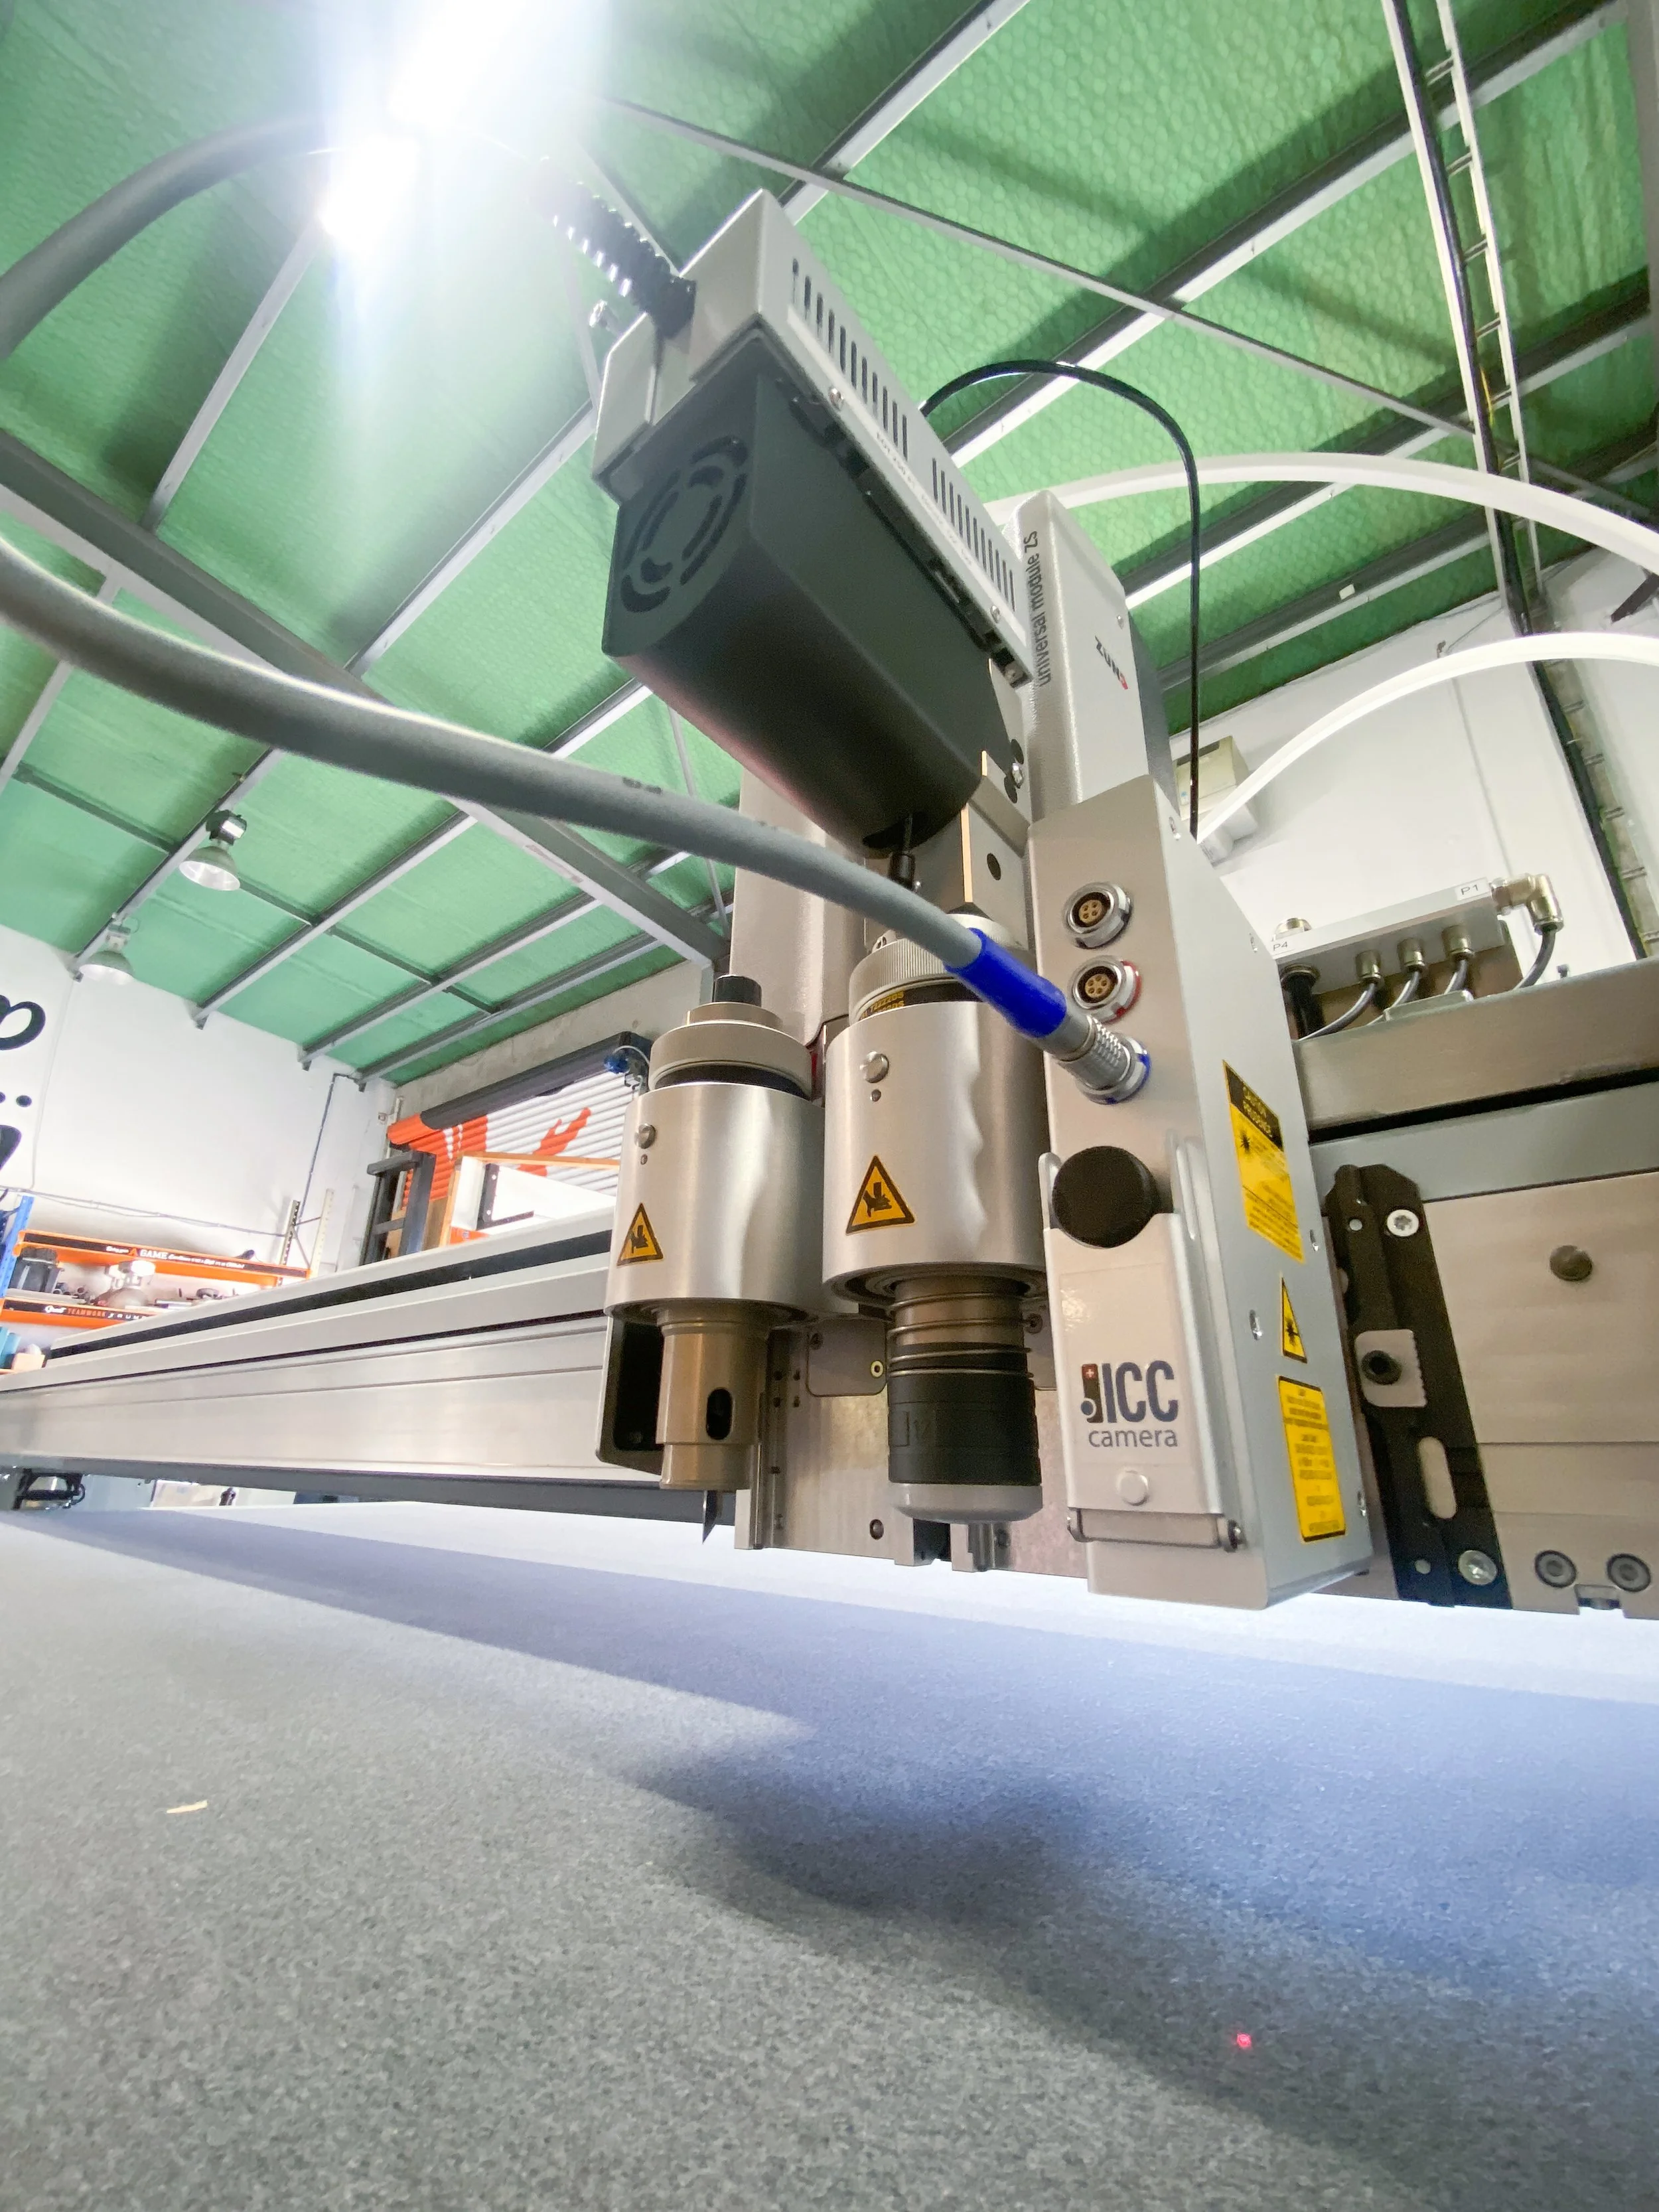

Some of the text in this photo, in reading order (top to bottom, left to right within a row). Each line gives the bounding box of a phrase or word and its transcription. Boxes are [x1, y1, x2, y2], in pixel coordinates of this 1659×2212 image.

[1023, 530, 1052, 688] universal module ZS
[1461, 884, 1479, 895] P1
[1273, 941, 1288, 951] P4
[139, 1248, 169, 1260] GAME
[67, 1307, 106, 1318] TEAMWORK
[1088, 1428, 1179, 1448] camera
